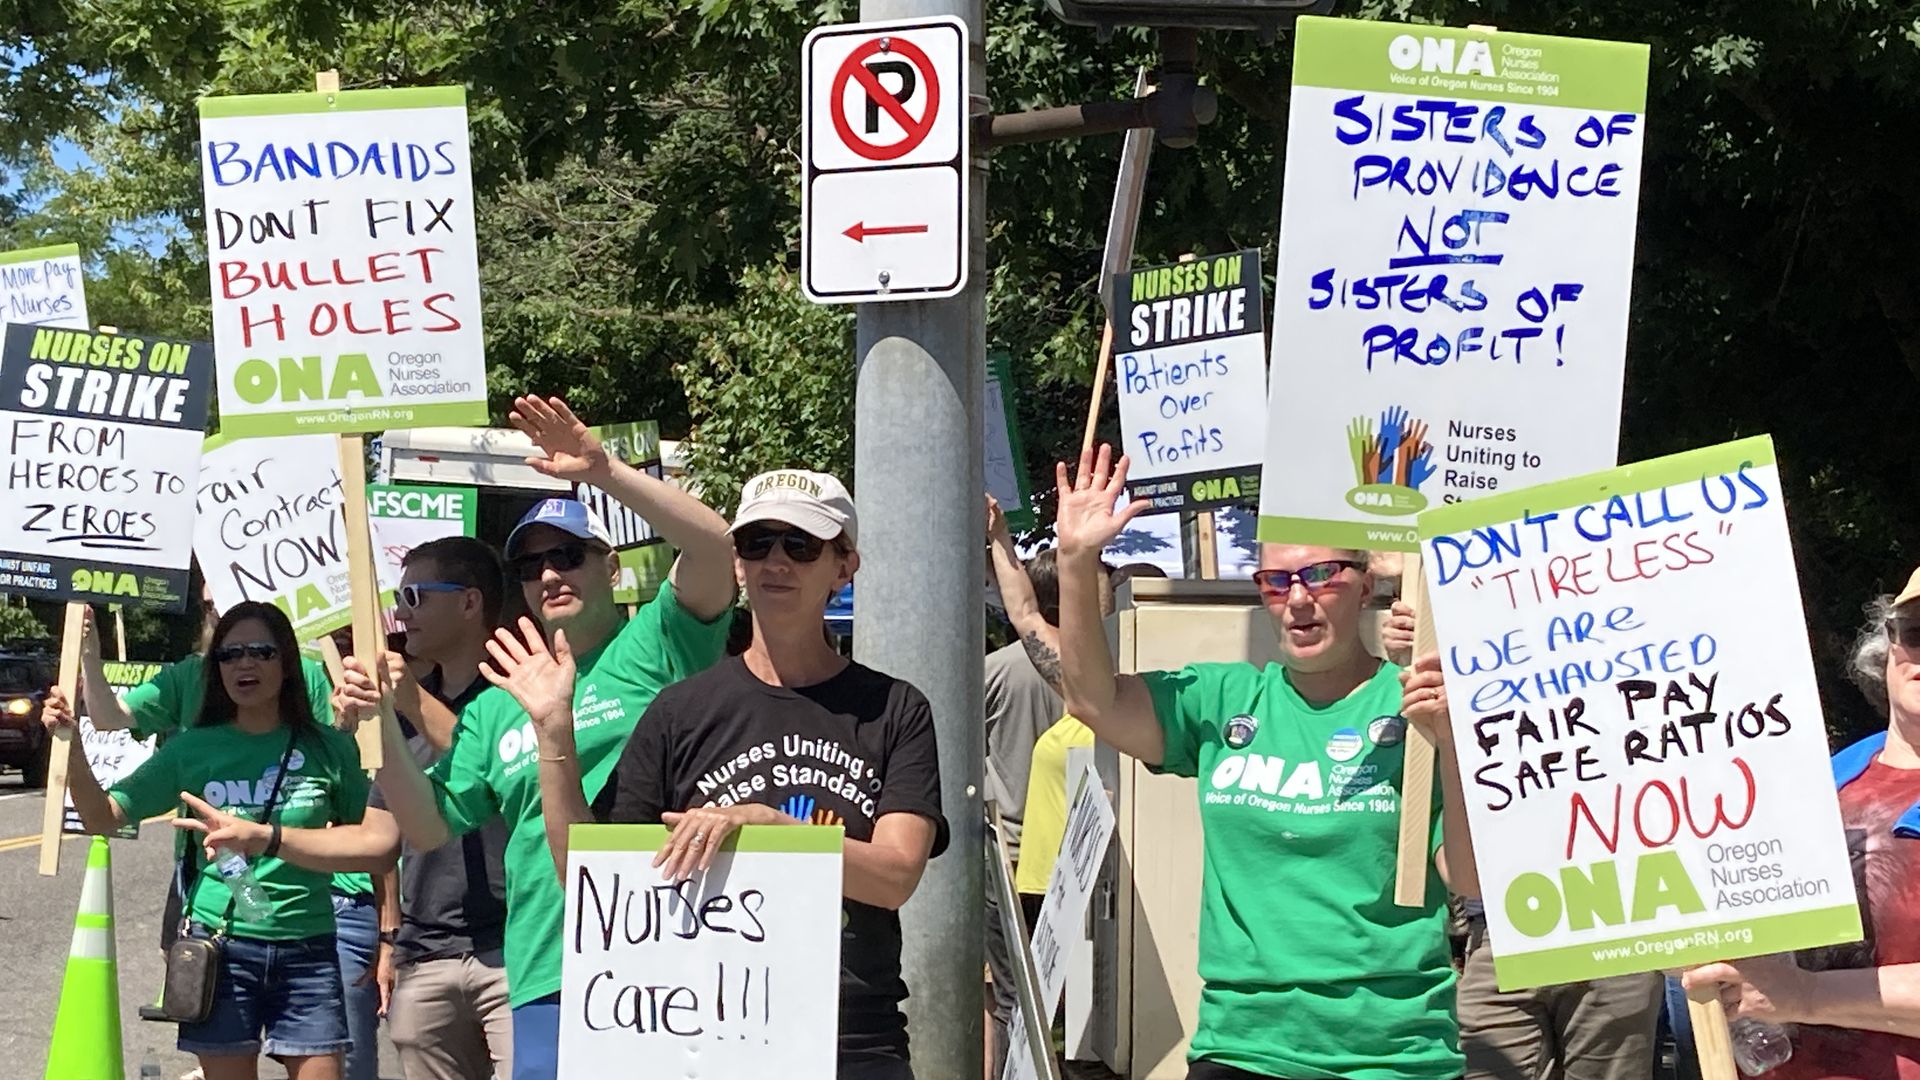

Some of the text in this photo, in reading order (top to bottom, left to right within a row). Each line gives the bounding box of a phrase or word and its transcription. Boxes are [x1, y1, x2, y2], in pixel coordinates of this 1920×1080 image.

[1388, 34, 1496, 77] ONA
[1501, 43, 1542, 58] Oregon
[1501, 56, 1539, 70] Nurses
[1389, 72, 1416, 85] Voice
[1418, 75, 1429, 86] of
[1431, 76, 1467, 91] Oregon
[1469, 79, 1505, 92] Nurses
[1506, 83, 1534, 95] Since
[1500, 68, 1560, 83] Association
[1333, 95, 1637, 158] SISTERS OF
[208, 141, 456, 187] BANDAIDS
[1354, 155, 1624, 201] PROVIDENCE
[366, 198, 454, 239] FIX
[1397, 206, 1510, 256] NOT
[219, 248, 444, 299] BULLET
[1131, 254, 1243, 302] NURSES ON
[11, 293, 72, 318] Nurses
[1308, 268, 1584, 323] SISTERS OF
[241, 293, 461, 348] HOLES
[1130, 287, 1246, 347] STRIKE
[30, 329, 191, 375] NURSES ON
[388, 351, 442, 367] Oregon
[1362, 324, 1565, 374] PROFIT!
[233, 353, 383, 404] ONA
[389, 368, 441, 381] Nurses
[390, 381, 471, 396] Association
[1122, 349, 1229, 394] Patients
[20, 364, 190, 423] STRIKE
[1160, 391, 1214, 419] Over
[295, 409, 415, 424] www.OregonRN.org
[1448, 420, 1516, 441] Nurses
[11, 420, 125, 460] FROM
[1138, 424, 1224, 466] Profits
[1446, 445, 1541, 471] Uniting to
[9, 459, 186, 495] HEROES TO
[754, 473, 822, 498] OREGON
[1192, 476, 1241, 502] ONA
[1444, 469, 1498, 490] Raise
[221, 468, 346, 550] Contract
[1353, 491, 1393, 508] ONA
[1574, 487, 1694, 542] CALL
[1701, 461, 1769, 514] US
[22, 503, 156, 538] ZEROES
[13, 574, 58, 590] PRACTICES
[71, 568, 140, 598] ONA
[1450, 629, 1532, 676] WE
[1473, 670, 1719, 757] FAIR PAY
[697, 741, 777, 796] Nurses
[783, 734, 865, 780] Uniting
[1331, 764, 1378, 776] Oregon
[1475, 693, 1792, 811] SAFE RATIOS
[1211, 753, 1323, 800] ONA
[1205, 792, 1396, 815] Voice of Oregon Nurses Since 1904
[1566, 756, 1756, 861] NOW
[1707, 839, 1783, 863] Oregon
[1504, 850, 1707, 938] ONA
[1711, 863, 1783, 888] Nurses
[1716, 877, 1830, 910] Association
[575, 865, 765, 953] Nurses
[1592, 928, 1753, 961] www.OregonRN.org
